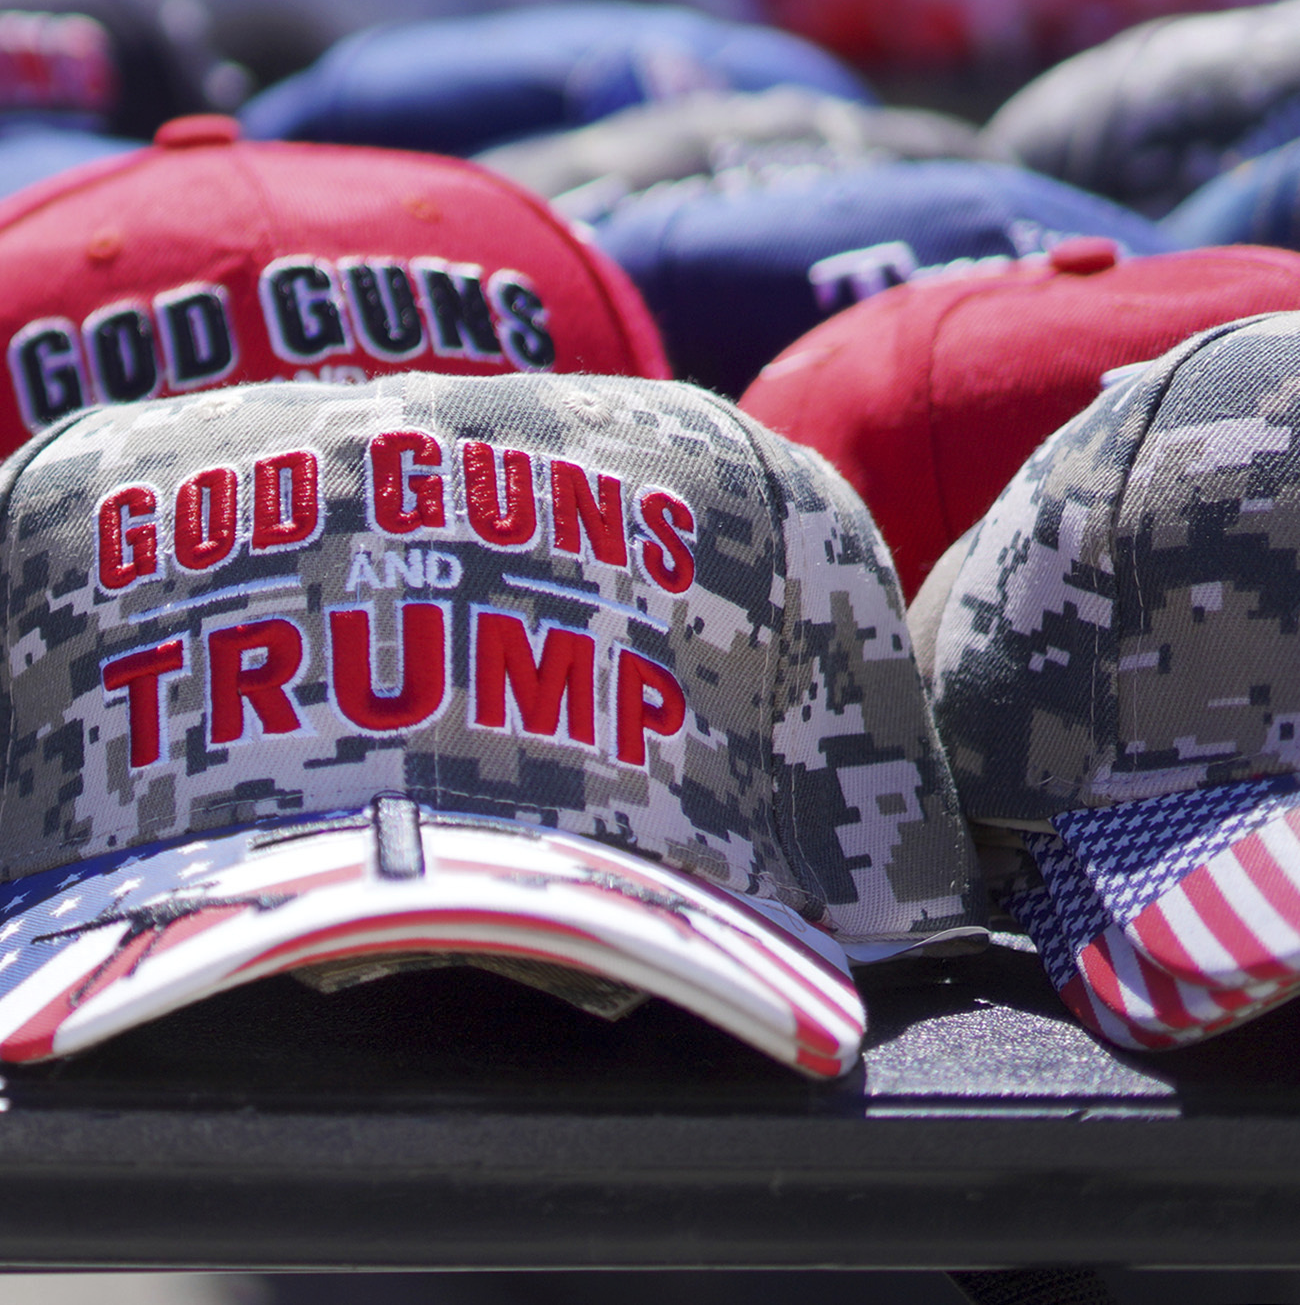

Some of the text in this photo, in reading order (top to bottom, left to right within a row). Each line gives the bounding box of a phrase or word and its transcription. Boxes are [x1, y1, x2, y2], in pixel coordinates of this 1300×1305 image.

[10, 255, 557, 433] GOD GUNS
[95, 427, 699, 596] GOD GUNS
[345, 545, 465, 592] AND
[100, 601, 689, 774] TRUMP
